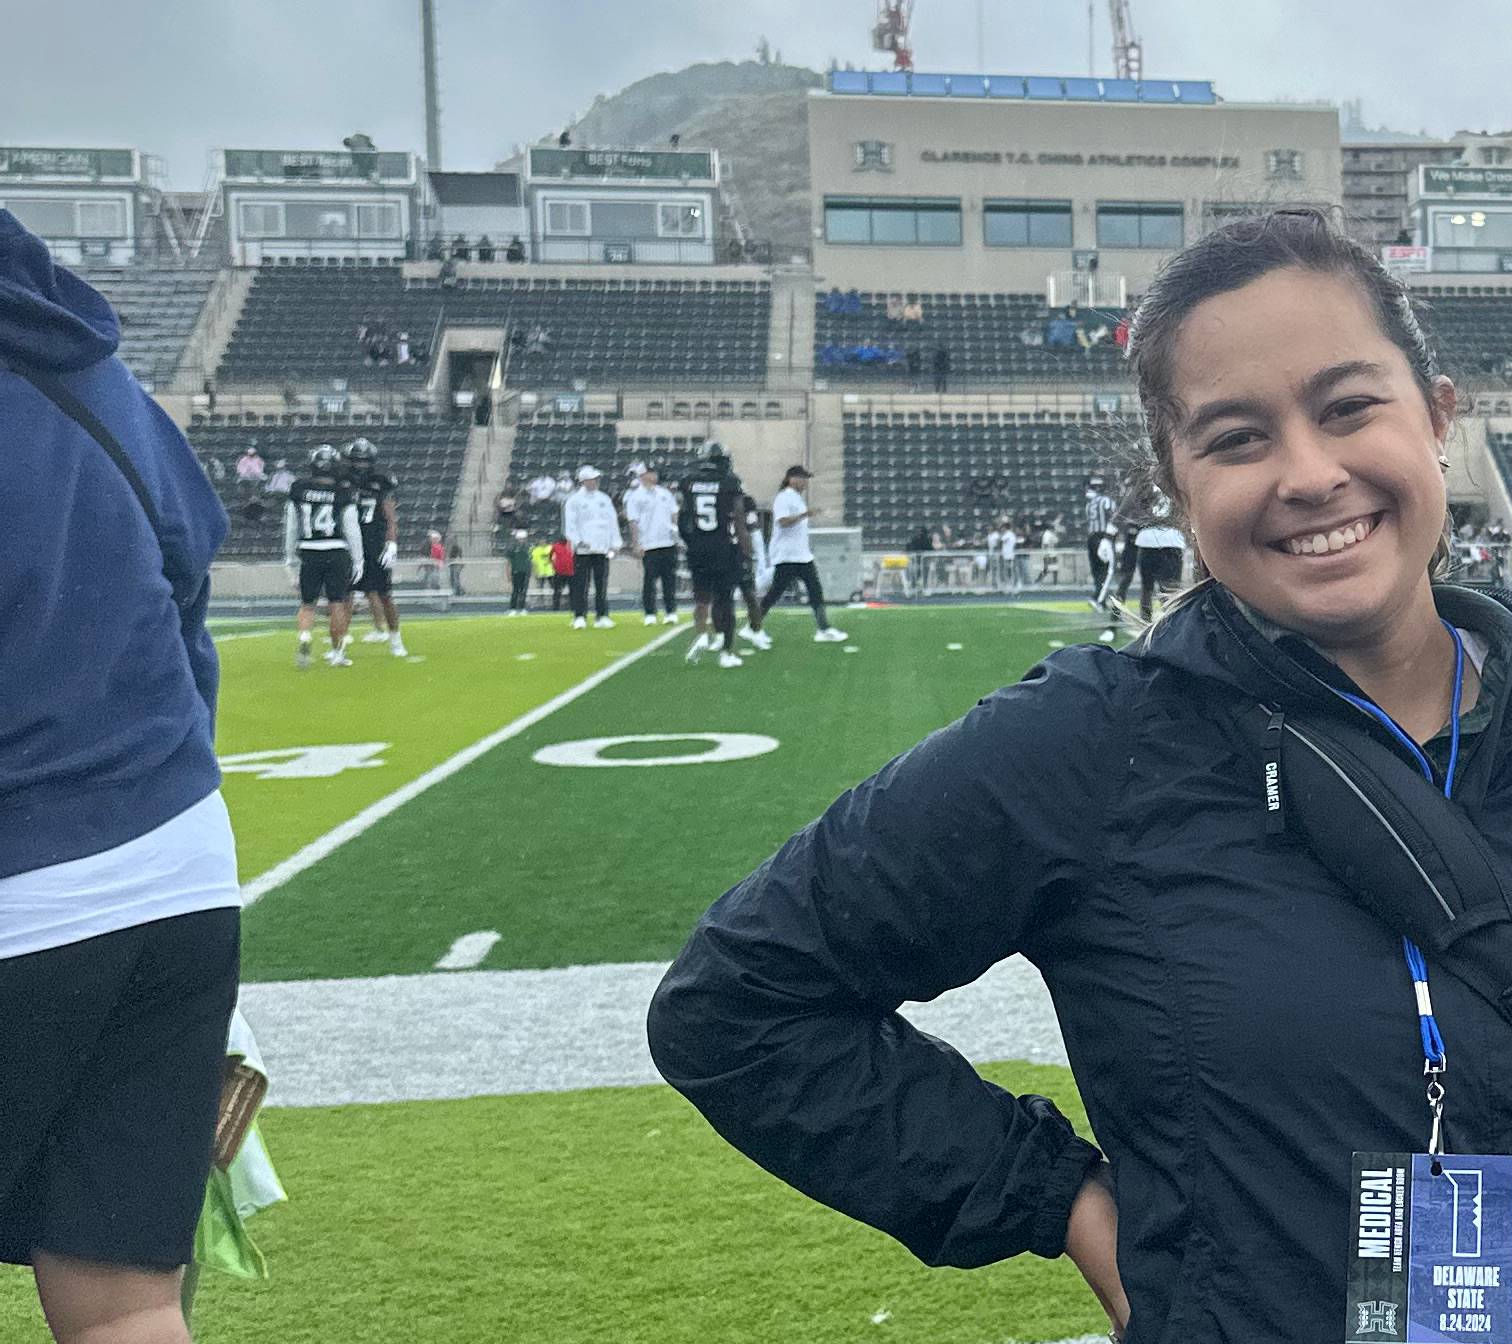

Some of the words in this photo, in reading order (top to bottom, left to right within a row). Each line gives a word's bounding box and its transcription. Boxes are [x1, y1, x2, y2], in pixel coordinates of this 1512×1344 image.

[920, 151, 1001, 163] CLARENCE
[1038, 153, 1083, 166] CHING
[1087, 154, 1166, 168] ATHLETICS
[1169, 156, 1239, 169] COMPLEX
[1430, 169, 1449, 182] We
[1453, 170, 1483, 183] Make
[301, 503, 336, 539] 14
[696, 494, 718, 532] 5
[1265, 762, 1280, 811] CRAMER
[1395, 1167, 1405, 1185] ROOM
[1358, 1167, 1393, 1258] MEDICAL
[1394, 1207, 1404, 1221] AND
[1392, 1256, 1402, 1273] TEAM
[1433, 1265, 1500, 1287] DELAWARE
[1447, 1288, 1485, 1309] STATE
[1439, 1313, 1492, 1332] 8.24.2024
